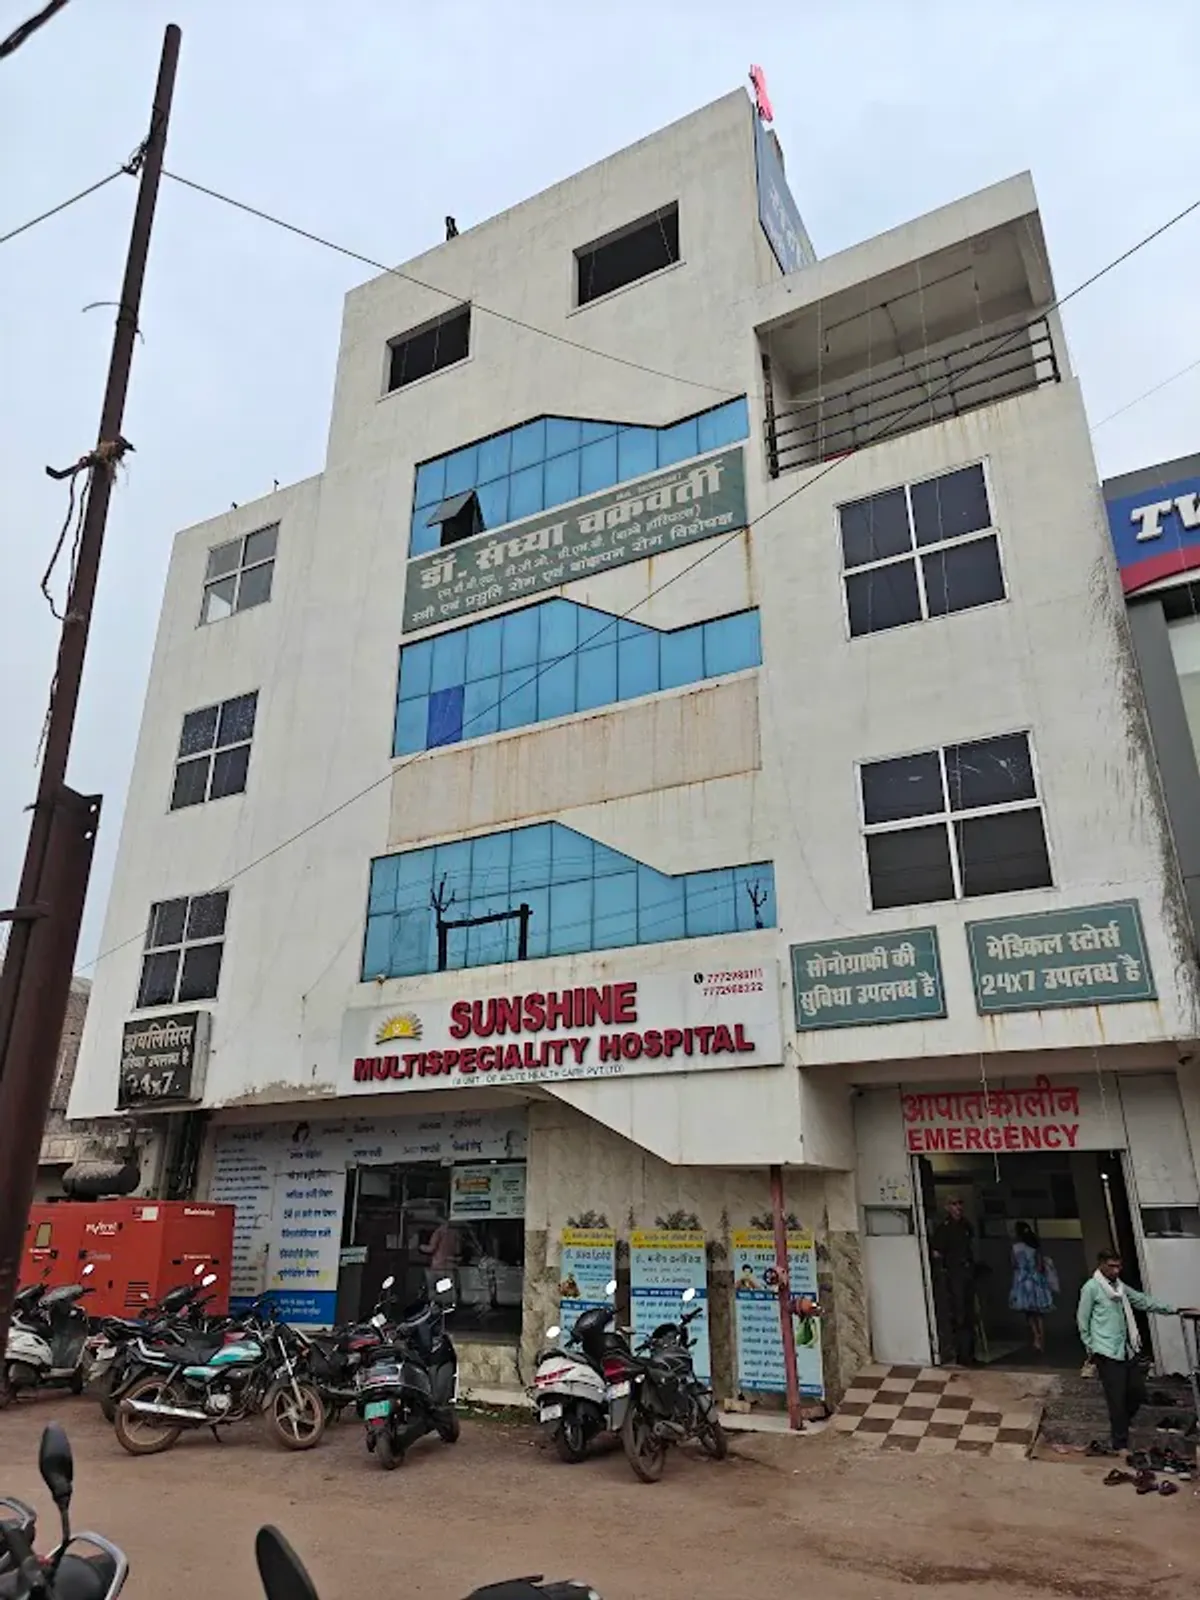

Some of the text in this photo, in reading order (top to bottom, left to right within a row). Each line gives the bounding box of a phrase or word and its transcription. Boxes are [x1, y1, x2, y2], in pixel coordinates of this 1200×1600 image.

[475, 520, 568, 570] संध्या
[577, 458, 725, 536] चक्रवर्ती
[890, 941, 916, 968] की
[986, 920, 1121, 960] मेडिकल स्टोर्स
[800, 971, 936, 1016] सुविधा उपलब्ध है
[1042, 962, 1119, 990] उपलब्ध
[1117, 953, 1142, 982] है
[449, 980, 639, 1040] SUNSHINE
[353, 1022, 756, 1082] MULTISPECIALITY HOSPITAL
[903, 1073, 1080, 1122] आपातकालीन
[907, 1123, 1080, 1151] EMERGENCY
